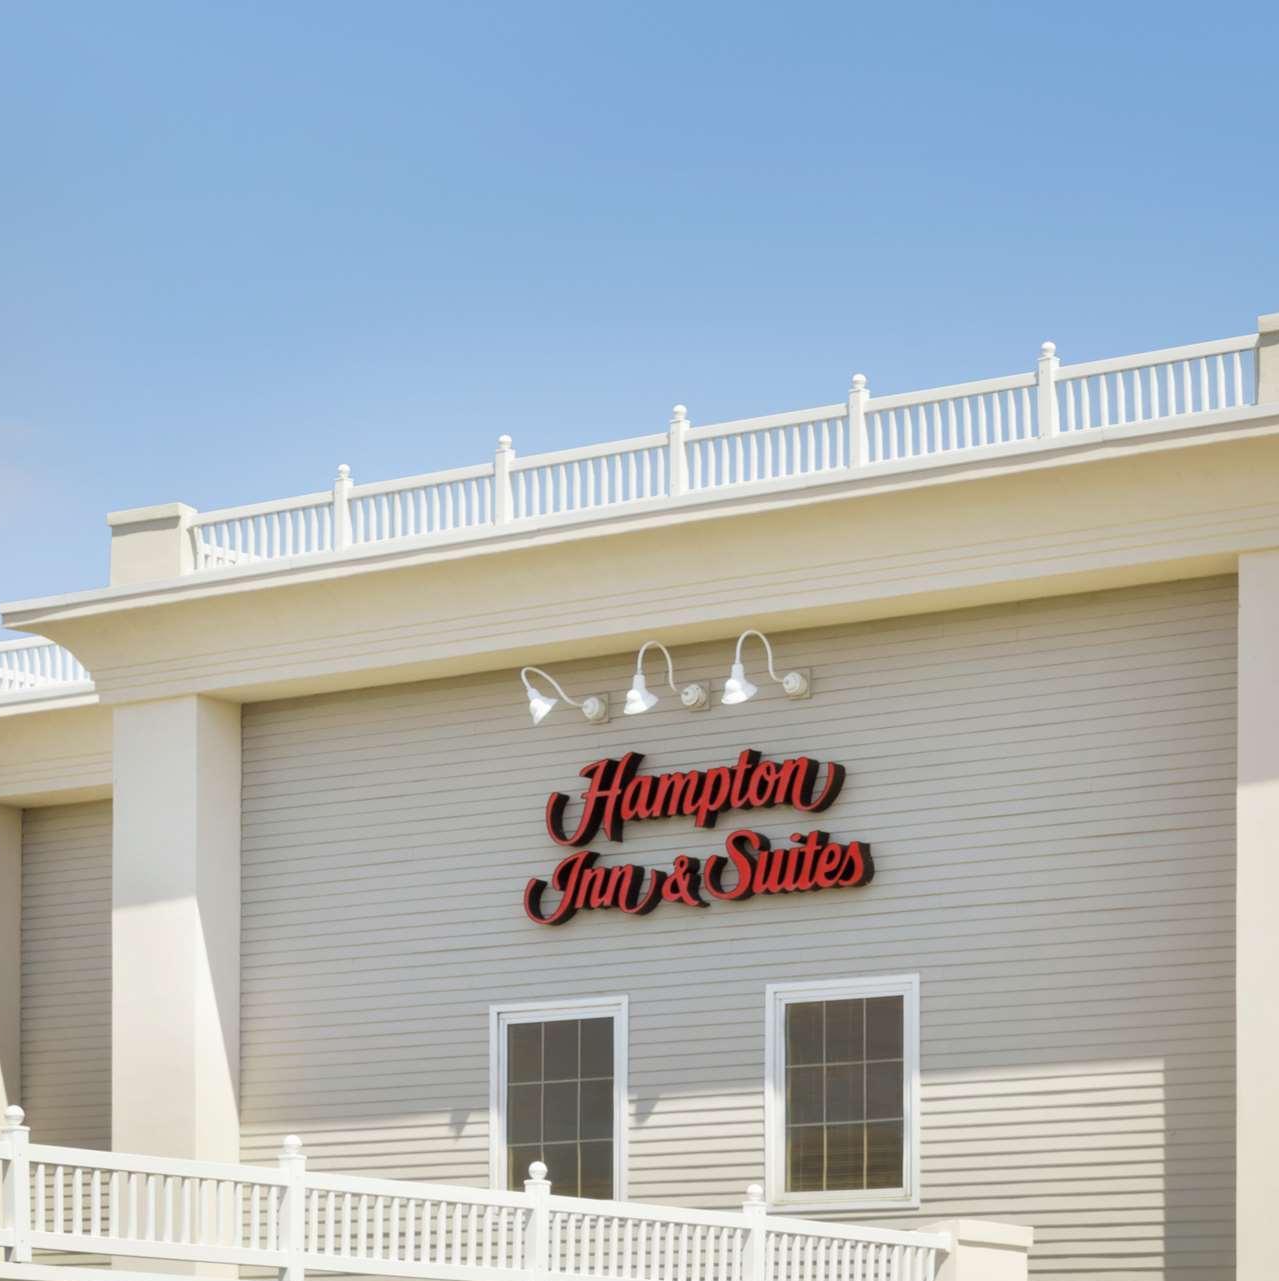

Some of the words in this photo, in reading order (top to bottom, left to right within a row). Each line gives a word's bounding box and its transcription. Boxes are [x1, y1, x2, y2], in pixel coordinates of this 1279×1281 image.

[546, 749, 846, 846] Hampton
[524, 850, 667, 926] Inn
[663, 855, 710, 908] &
[704, 829, 875, 901] Suites
